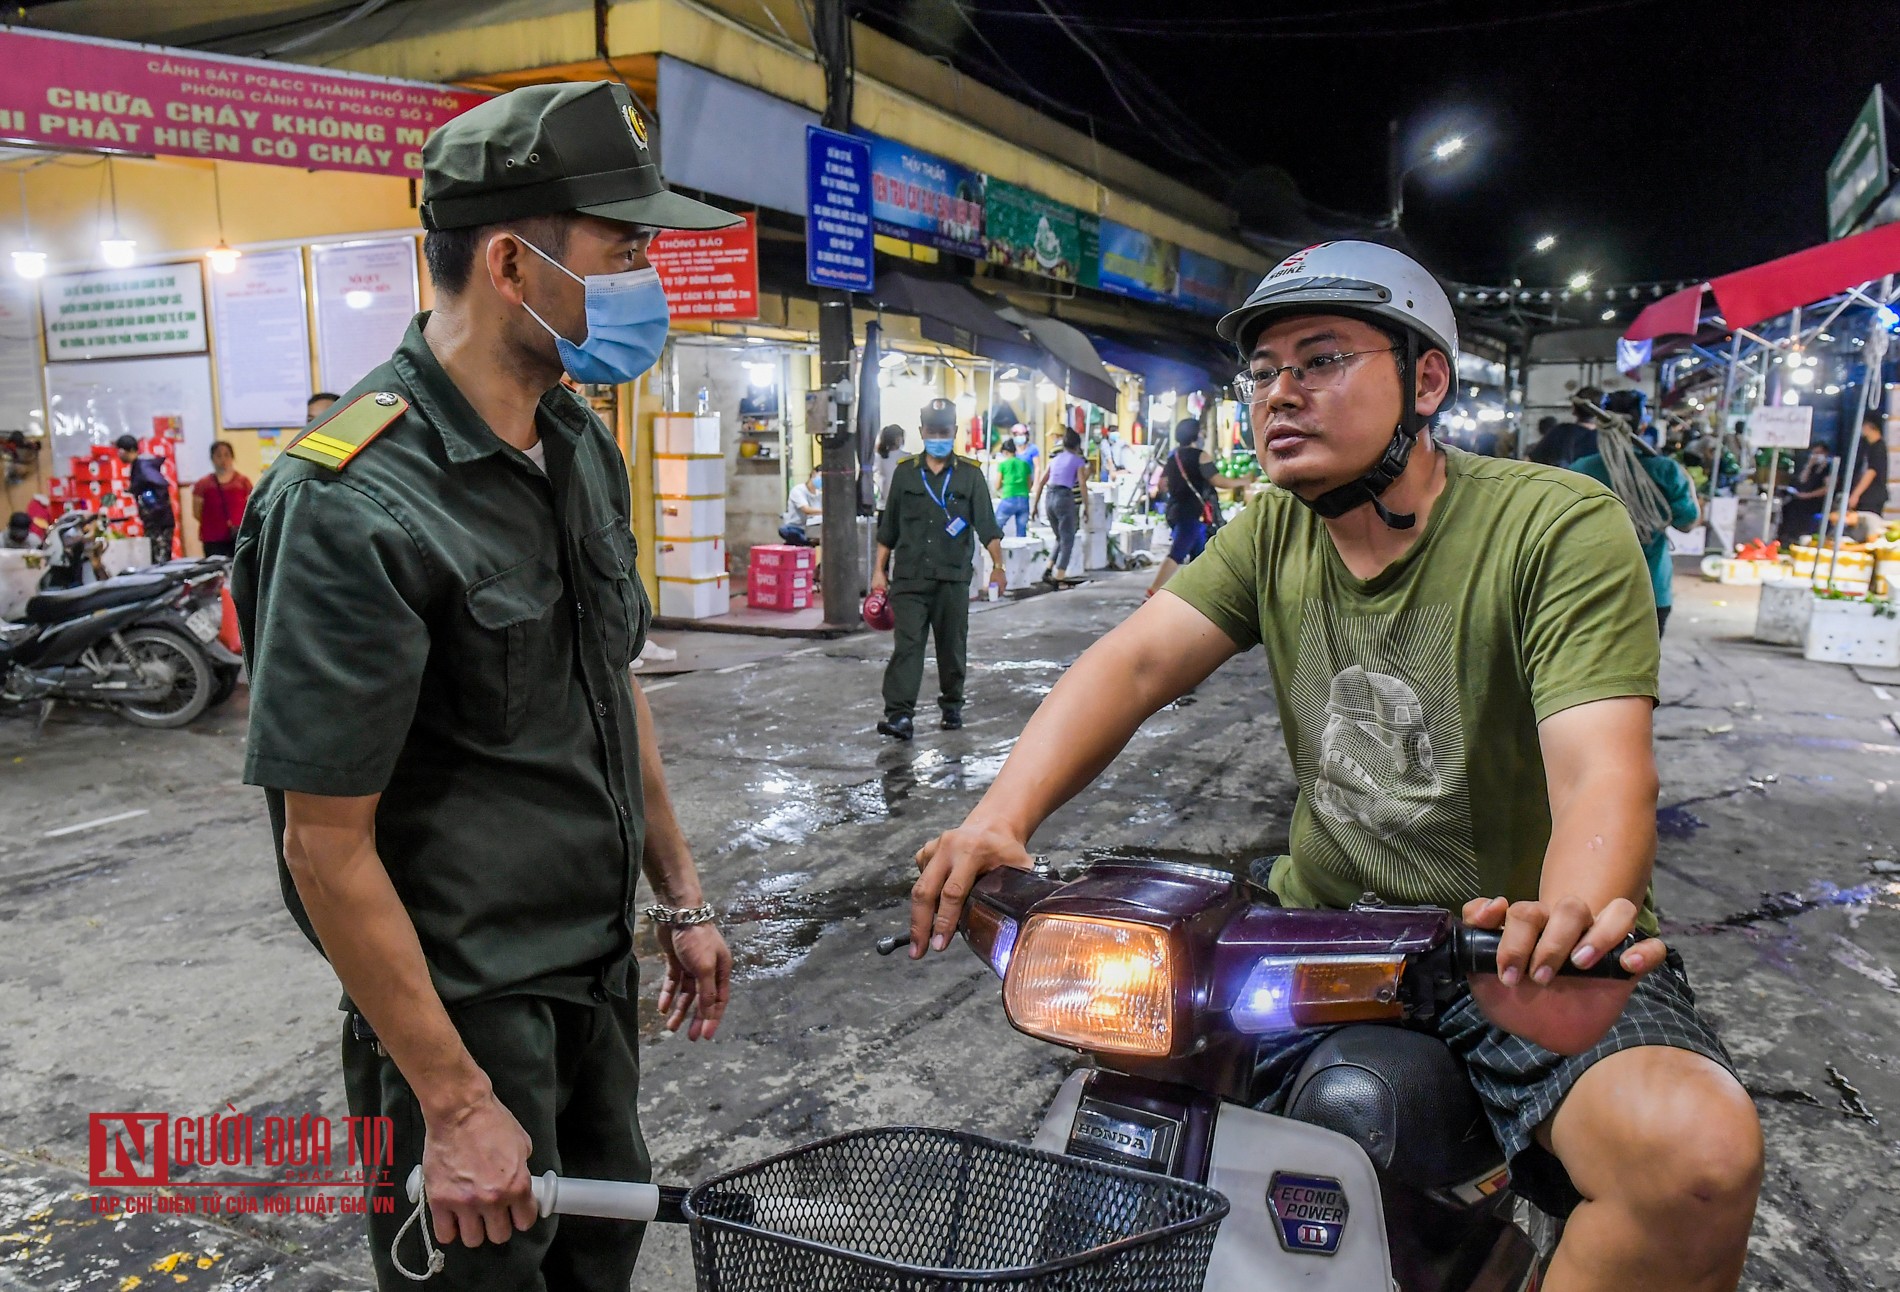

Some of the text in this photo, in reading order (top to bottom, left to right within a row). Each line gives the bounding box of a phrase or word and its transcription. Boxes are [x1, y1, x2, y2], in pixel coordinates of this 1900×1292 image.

[147, 58, 459, 110] CẢNH SÁT PC&CC THÀNH PHỐ HÀ NỘI
[47, 87, 154, 118] CHỮA
[166, 102, 260, 130] CHÁY
[272, 113, 386, 143] KHÔNG
[181, 82, 245, 100] PHÒNG
[250, 90, 298, 107] CẢNH
[303, 97, 335, 110] SÁT
[340, 101, 396, 117] PC&CC
[400, 107, 422, 121] SỐ
[39, 113, 141, 143] PHÁT
[154, 126, 240, 154] HIỆN
[251, 137, 297, 159] CÓ
[308, 143, 393, 167] CHÁY
[658, 236, 723, 249] THÔNG BÁO
[1077, 1123, 1146, 1151] HONDA
[1281, 1187, 1337, 1206] ECONO
[1284, 1203, 1344, 1222] POWER
